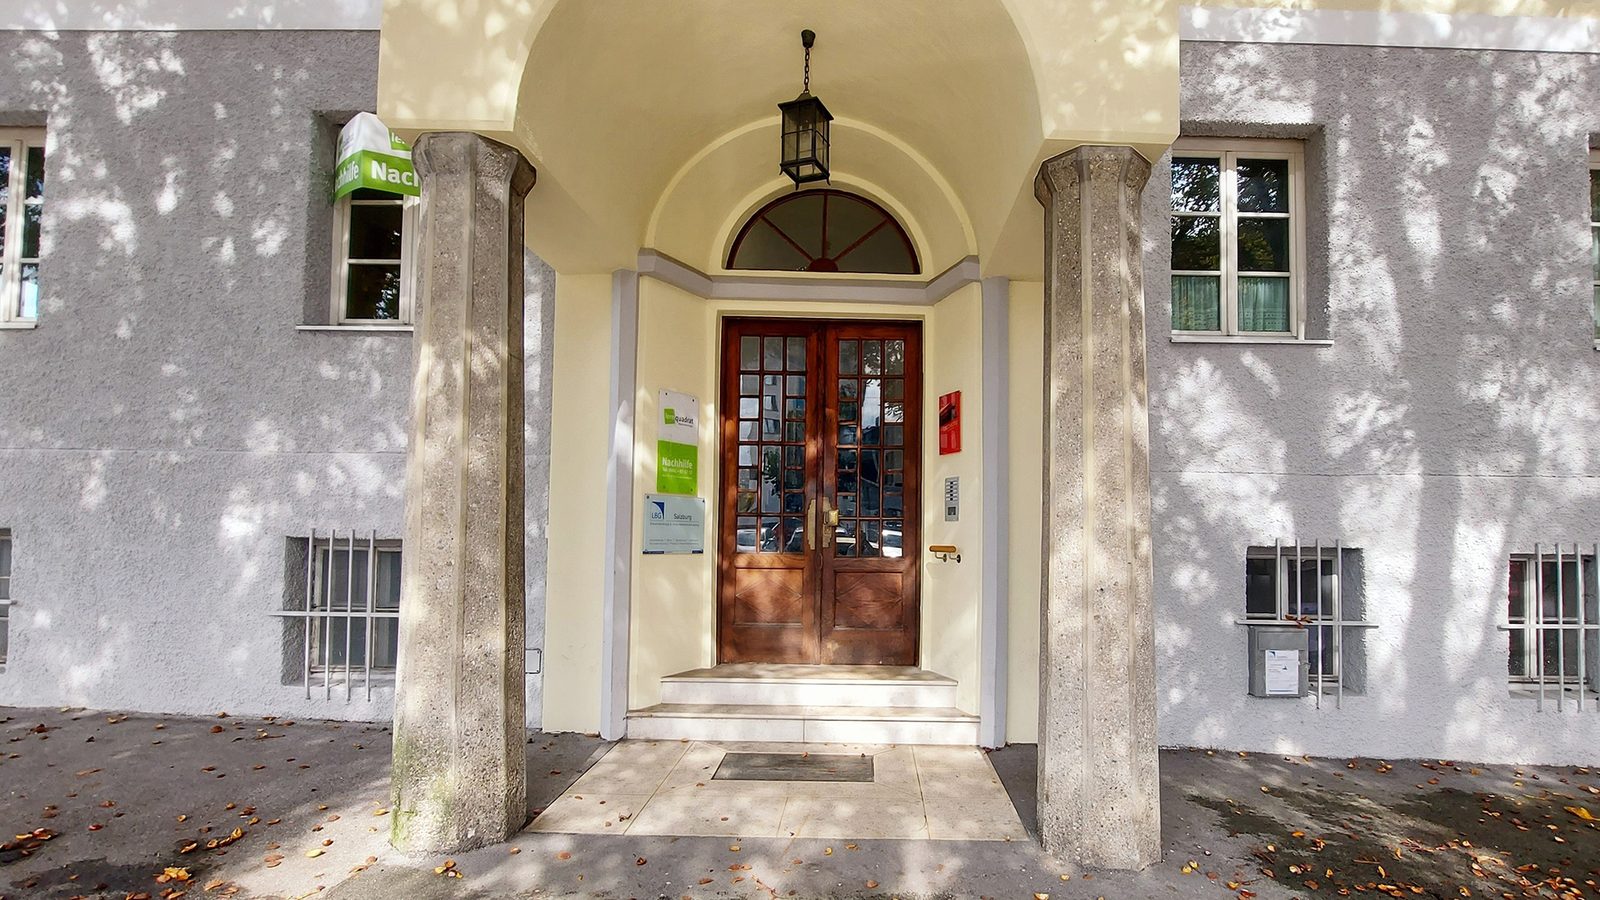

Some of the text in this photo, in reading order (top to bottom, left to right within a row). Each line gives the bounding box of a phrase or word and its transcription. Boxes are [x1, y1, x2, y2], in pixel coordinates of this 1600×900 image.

[662, 457, 693, 470] Nachhilfe
[651, 511, 662, 520] LBG
[673, 512, 693, 521] Salzburg
